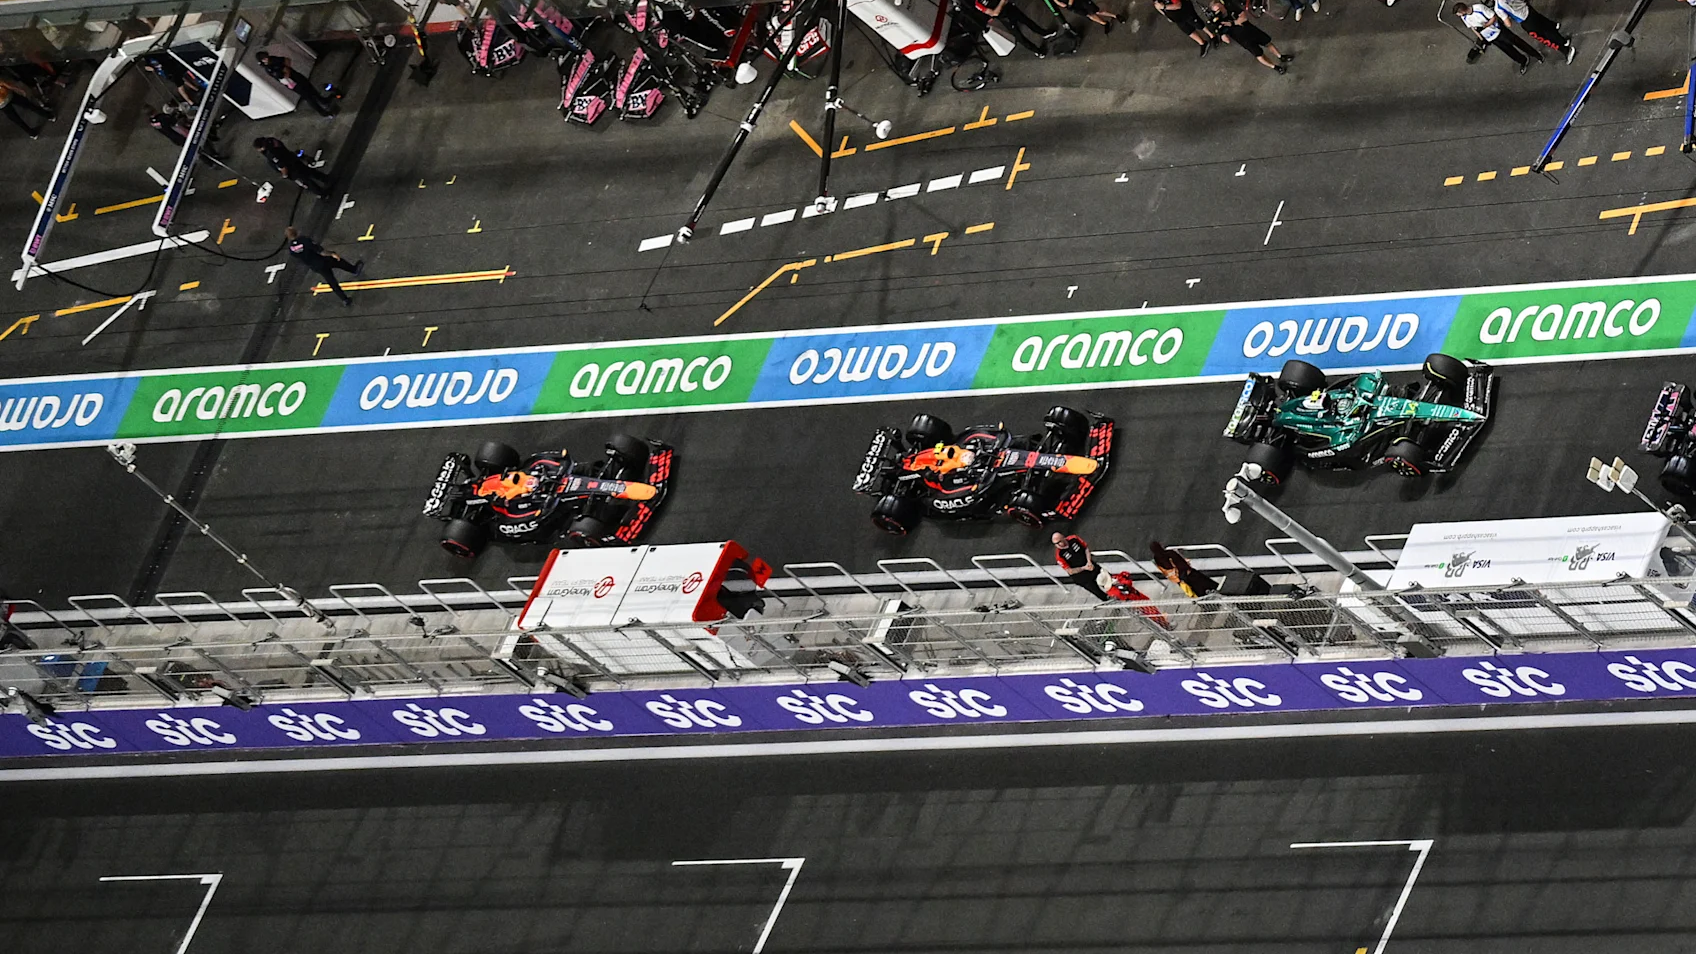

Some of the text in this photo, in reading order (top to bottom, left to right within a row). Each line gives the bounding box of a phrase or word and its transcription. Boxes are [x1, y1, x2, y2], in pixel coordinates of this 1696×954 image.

[1243, 313, 1420, 357] aramco
[1480, 298, 1661, 344] aramco
[789, 342, 957, 385] aramco
[1012, 328, 1183, 372] aramco
[360, 369, 519, 411] aramco
[570, 356, 732, 398] aramco
[152, 382, 307, 423] aramco
[1405, 402, 1418, 415] 14
[1435, 427, 1460, 462] aramco
[933, 496, 974, 510] ORACLE
[499, 520, 538, 535] ORACLE
[1472, 559, 1491, 569] VISA
[1596, 552, 1616, 562] VISA
[547, 587, 592, 597] MoneyGram
[634, 583, 681, 593] MoneyGram
[1044, 677, 1144, 714] stc
[1180, 671, 1283, 709] stc
[1320, 666, 1424, 703] stc
[1462, 660, 1566, 698] stc
[518, 699, 615, 733] stc
[645, 694, 742, 729] stc
[776, 688, 874, 724] stc
[909, 683, 1008, 719] stc
[27, 717, 117, 750] stc
[145, 713, 237, 746] stc
[268, 708, 361, 742] stc
[392, 703, 486, 738] stc
